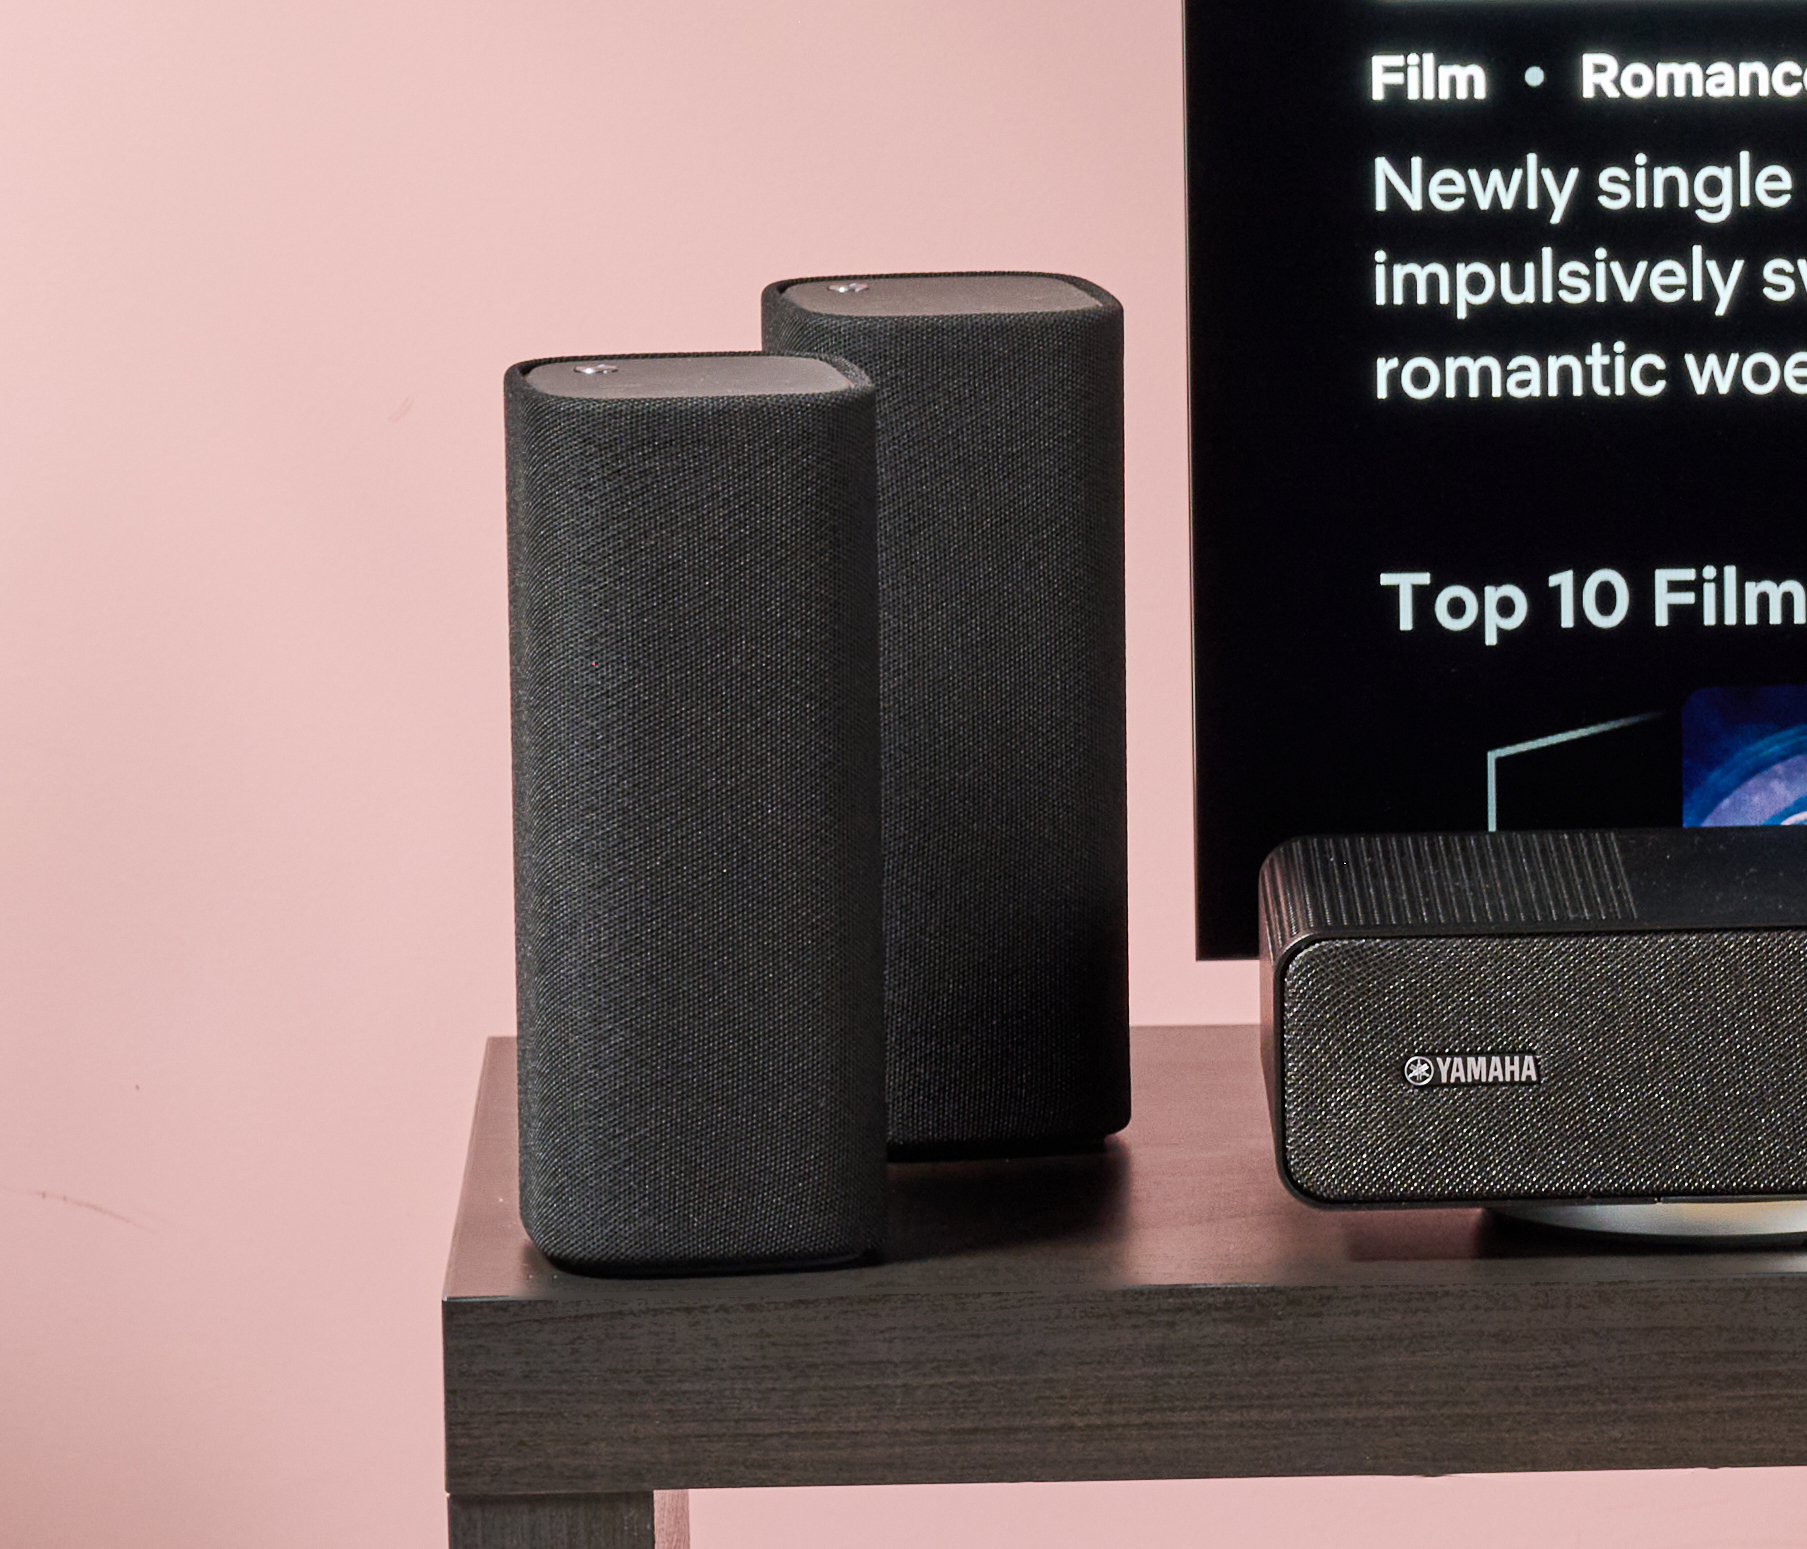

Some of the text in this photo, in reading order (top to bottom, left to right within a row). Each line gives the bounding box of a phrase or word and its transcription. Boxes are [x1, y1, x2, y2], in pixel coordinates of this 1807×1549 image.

[1372, 52, 1487, 101] Film
[1375, 153, 1579, 224] Newly
[1598, 151, 1792, 223] single
[1375, 245, 1744, 319] impulsively
[1377, 341, 1666, 400] romantic
[1380, 572, 1527, 646] Top
[1549, 569, 1629, 628] 10
[1436, 1055, 1538, 1083] YAMAHA
